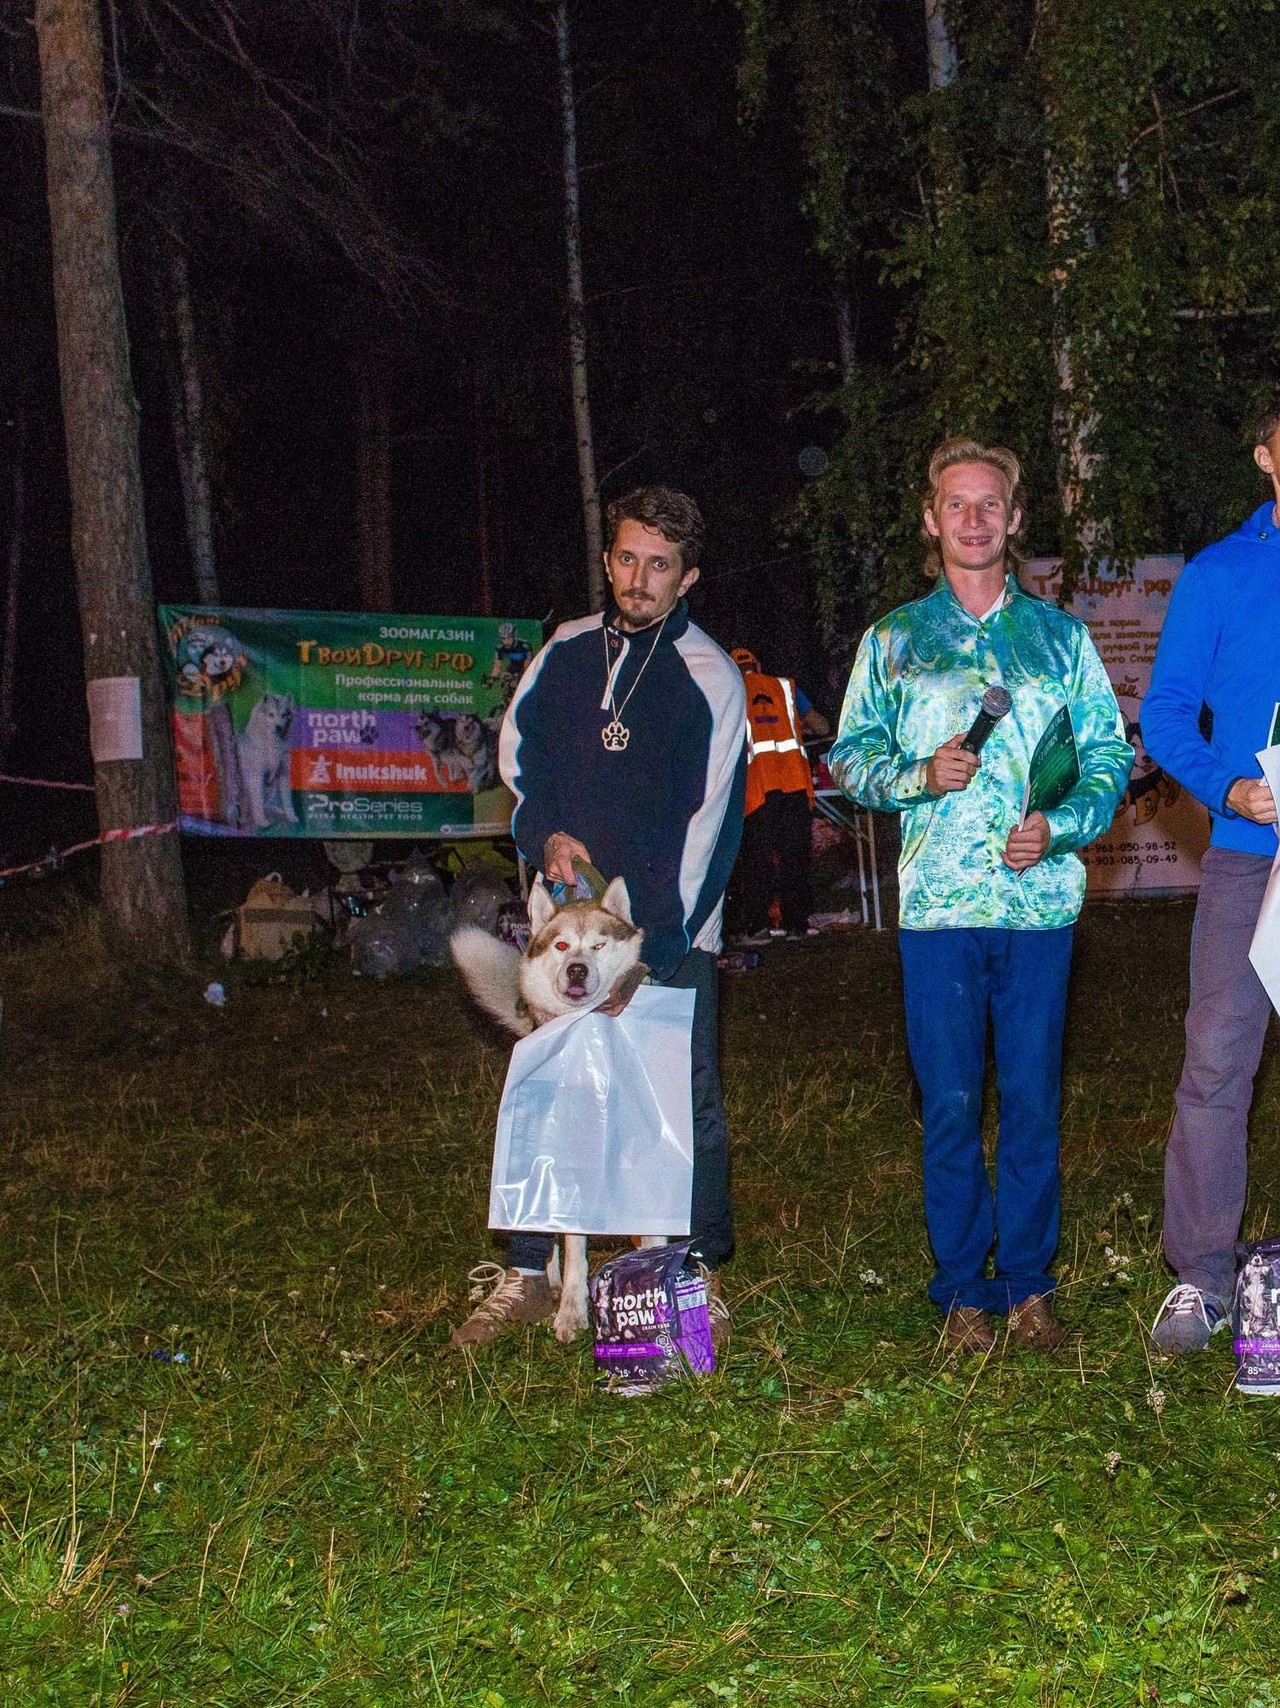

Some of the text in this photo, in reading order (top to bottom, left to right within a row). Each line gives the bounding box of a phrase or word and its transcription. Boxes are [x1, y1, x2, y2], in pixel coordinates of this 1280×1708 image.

[379, 626, 475, 642] ЗООМАГАЗИН
[336, 674, 475, 690] Профессиональные
[358, 691, 474, 705] корма для собак
[308, 710, 377, 728] north
[312, 727, 362, 748] paw
[336, 763, 428, 781] Inukshuk
[307, 794, 424, 813] ProSeries
[612, 1287, 668, 1312] north
[616, 1309, 655, 1332] paw
